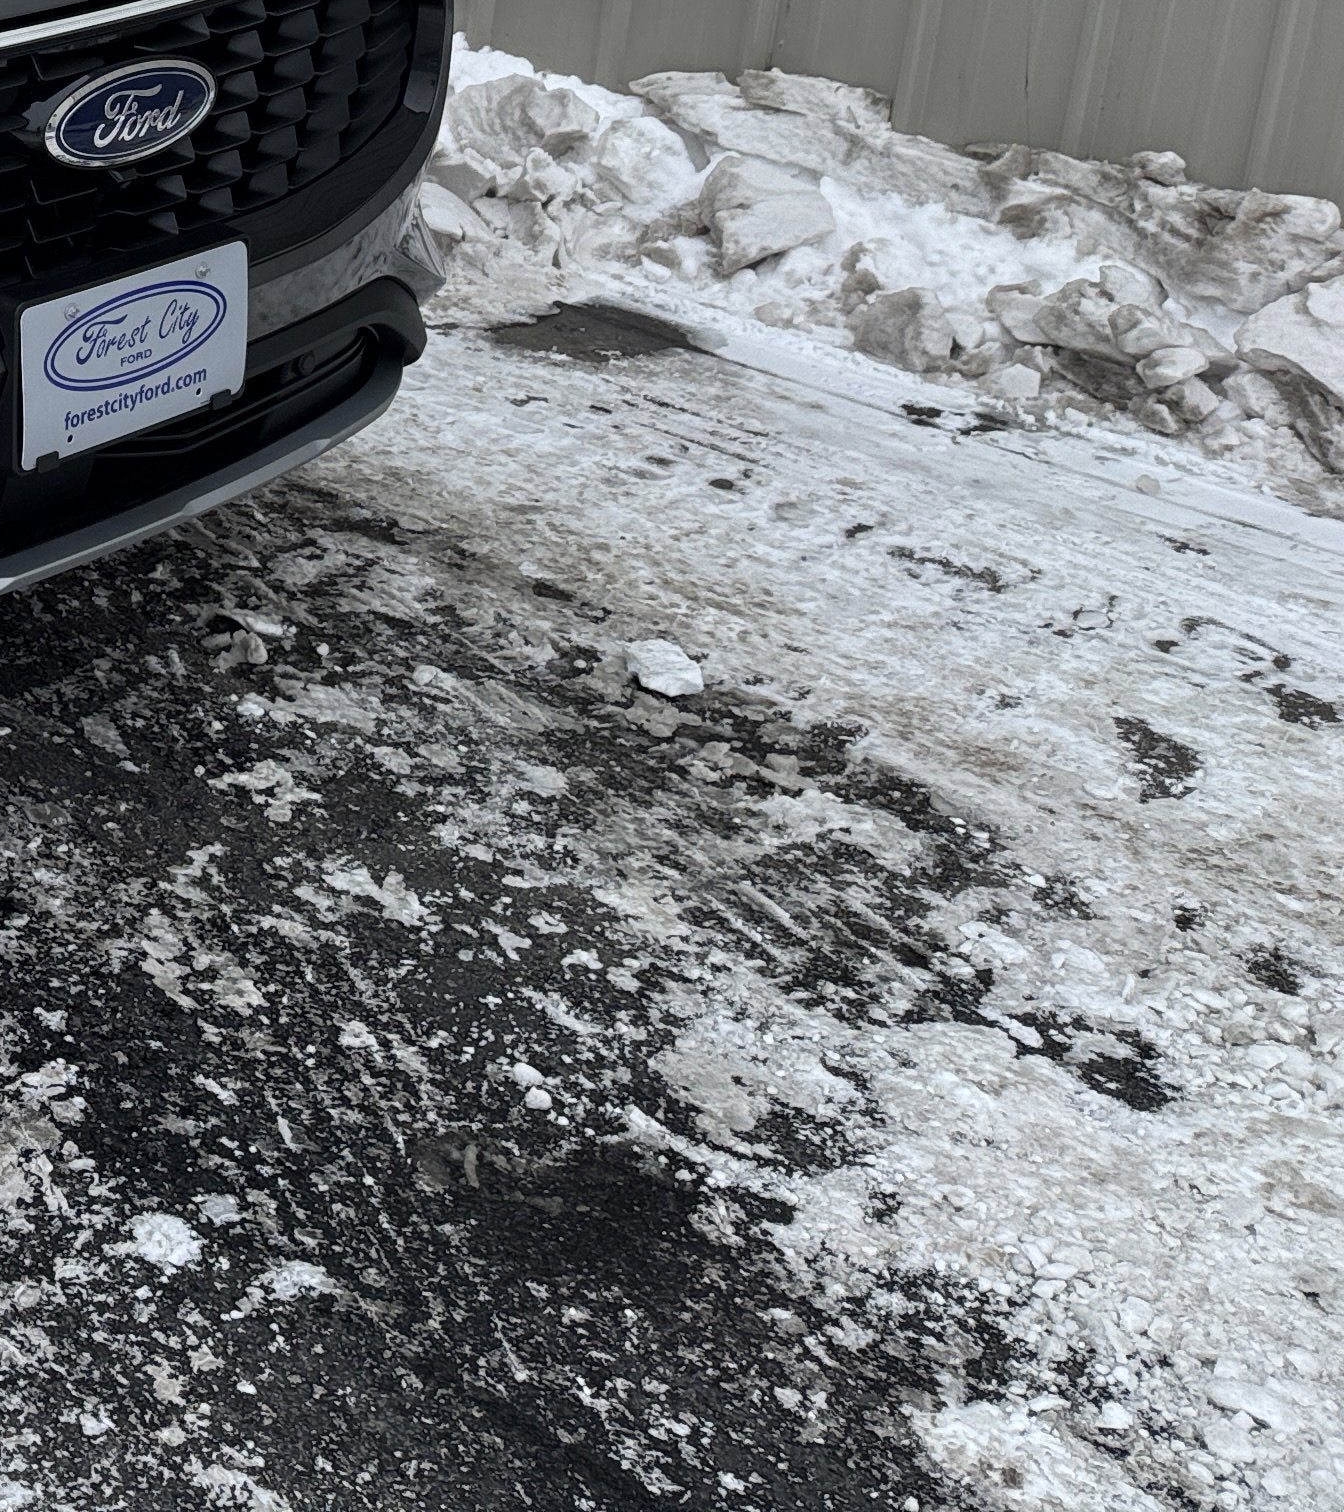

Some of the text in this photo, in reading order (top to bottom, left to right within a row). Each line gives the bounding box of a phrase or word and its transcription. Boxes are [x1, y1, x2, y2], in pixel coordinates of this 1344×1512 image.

[92, 82, 186, 149] Ford
[76, 298, 201, 366] Forest City
[119, 347, 153, 368] FORD
[63, 366, 208, 432] forestcityford.com
